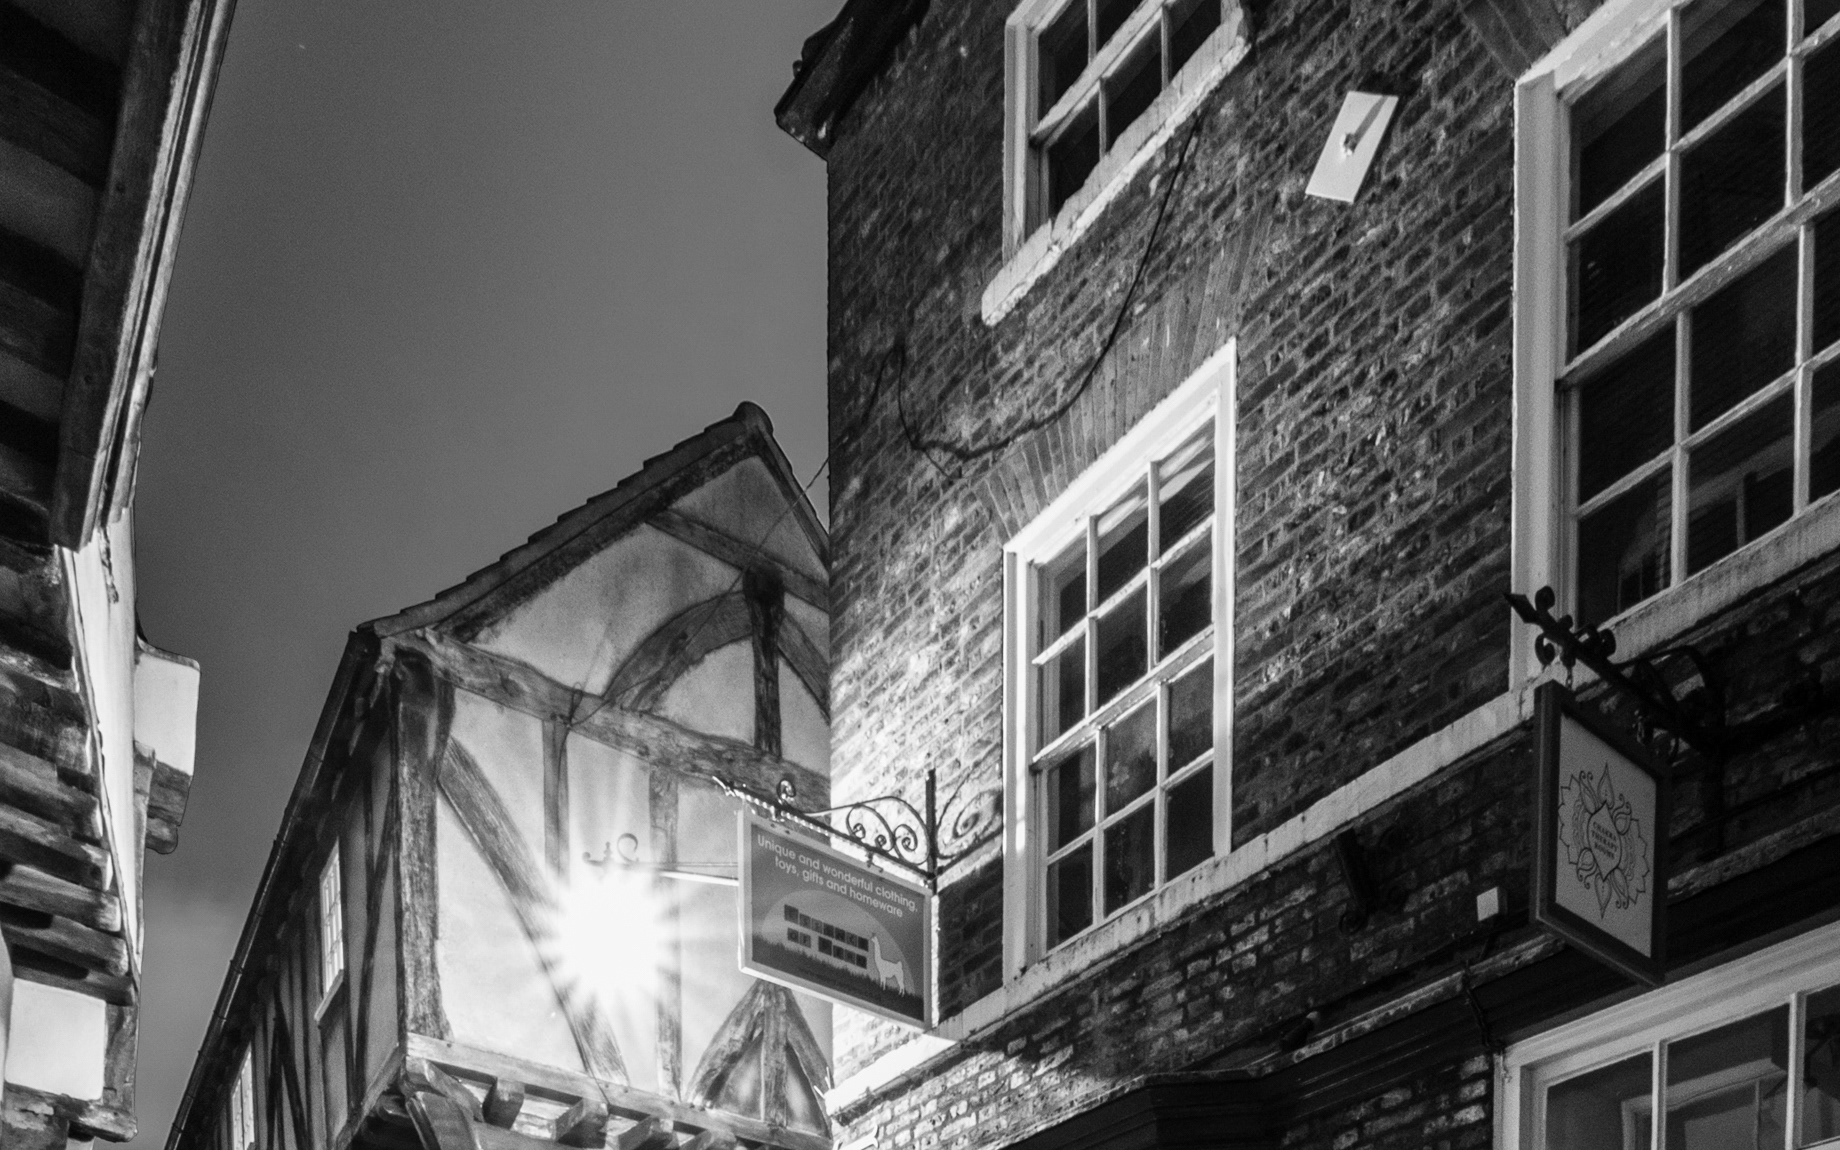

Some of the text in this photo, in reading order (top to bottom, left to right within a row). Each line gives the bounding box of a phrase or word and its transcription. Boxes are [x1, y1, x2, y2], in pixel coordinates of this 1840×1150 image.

[1591, 829, 1618, 852] THERAPY
[757, 835, 919, 913] Unique and wonderful clothing,
[774, 855, 904, 918] toys, gifts and homeware
